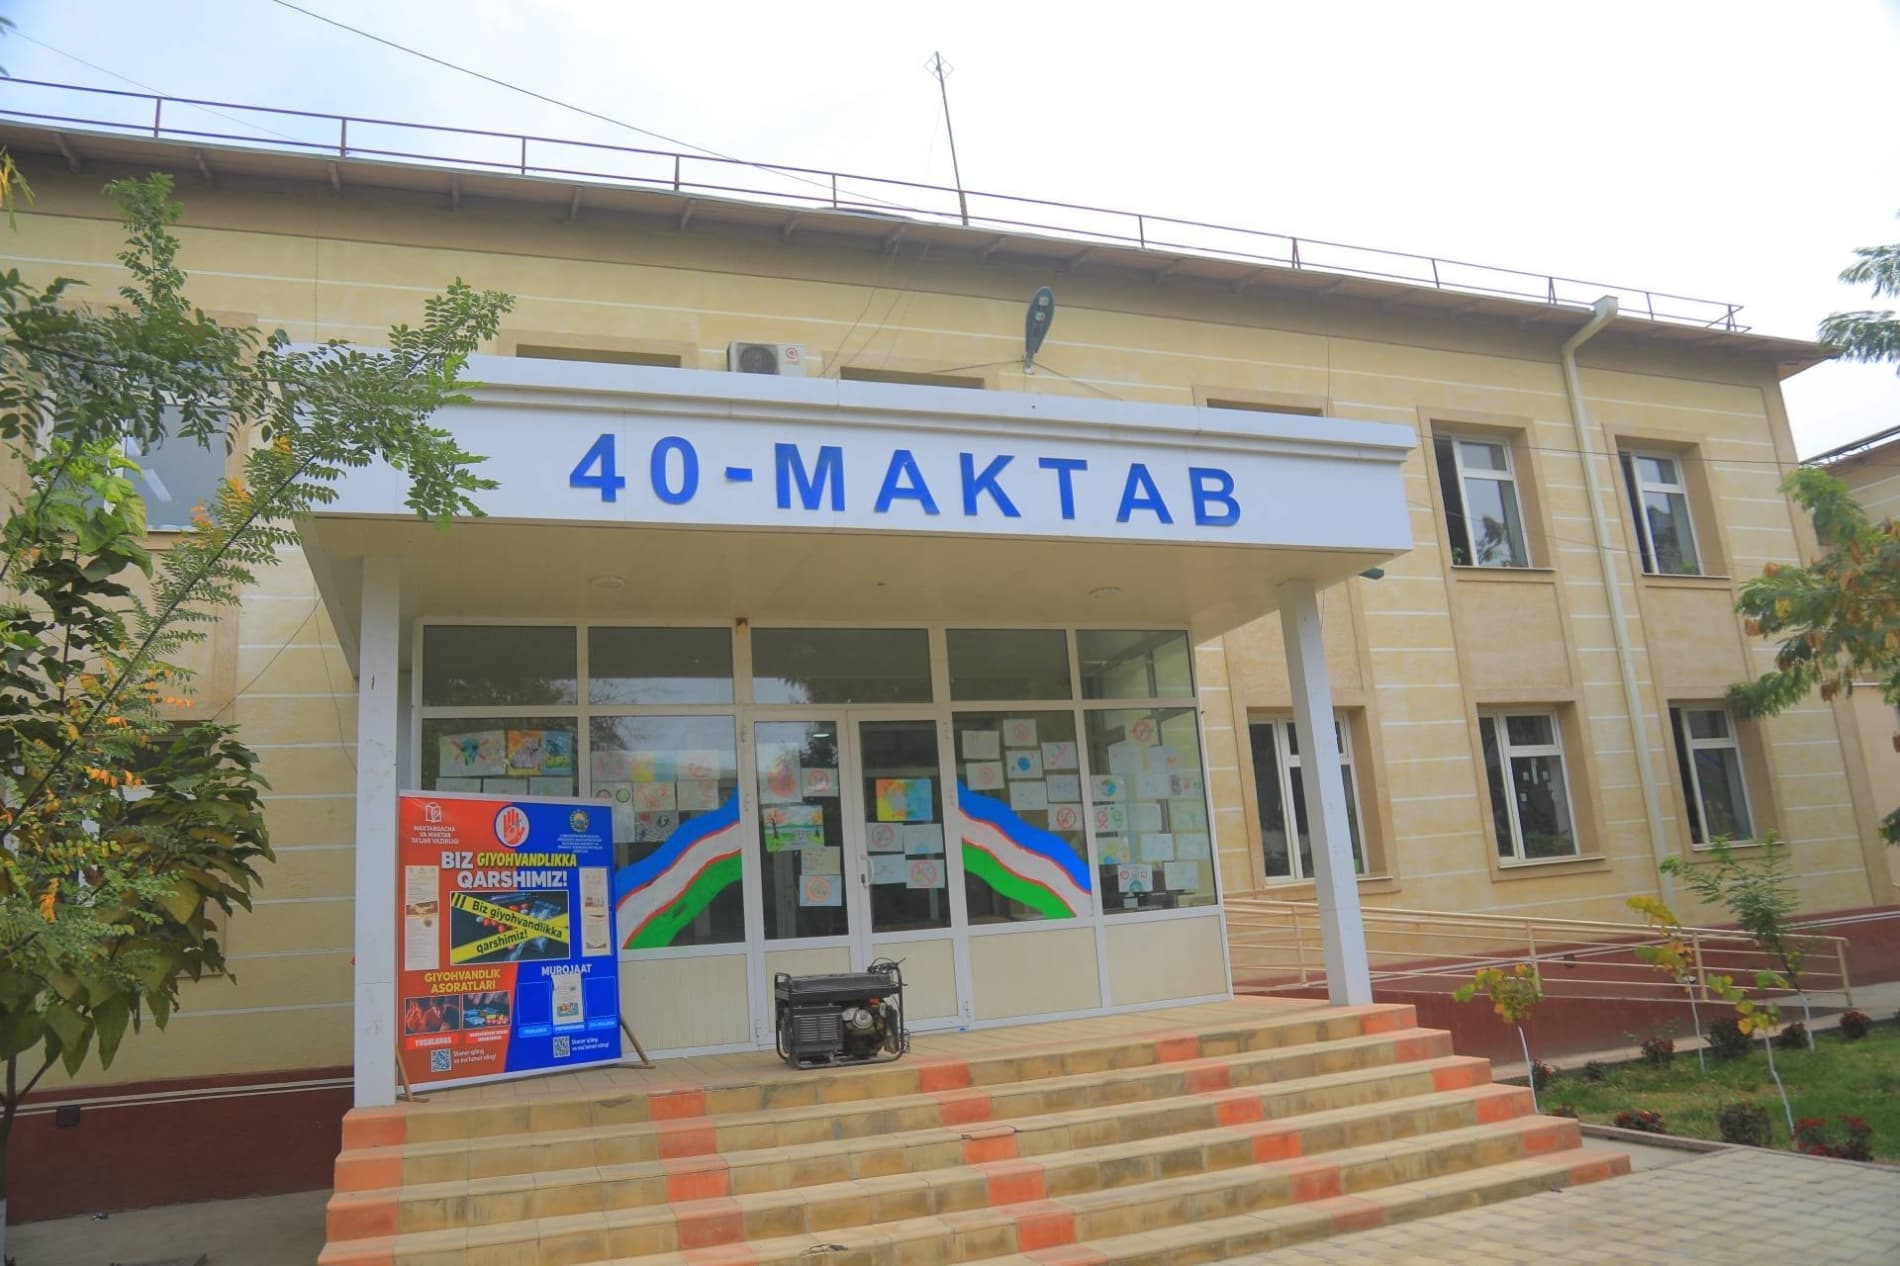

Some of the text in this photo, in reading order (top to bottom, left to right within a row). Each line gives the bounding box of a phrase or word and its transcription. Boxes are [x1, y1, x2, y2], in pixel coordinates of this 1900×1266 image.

[569, 433, 1241, 527] 40-MAKTAB
[441, 851, 577, 869] BIZ GIYOHVANDLIKKA
[457, 870, 568, 889] QARSHIMIZ!
[472, 900, 563, 938] Biz giyohvandlikka
[476, 929, 528, 953] qarshimiz!
[424, 968, 501, 983] GIYOHVANDLIK
[541, 963, 592, 977] MUROJAAT
[431, 980, 496, 994] ASORATLARI
